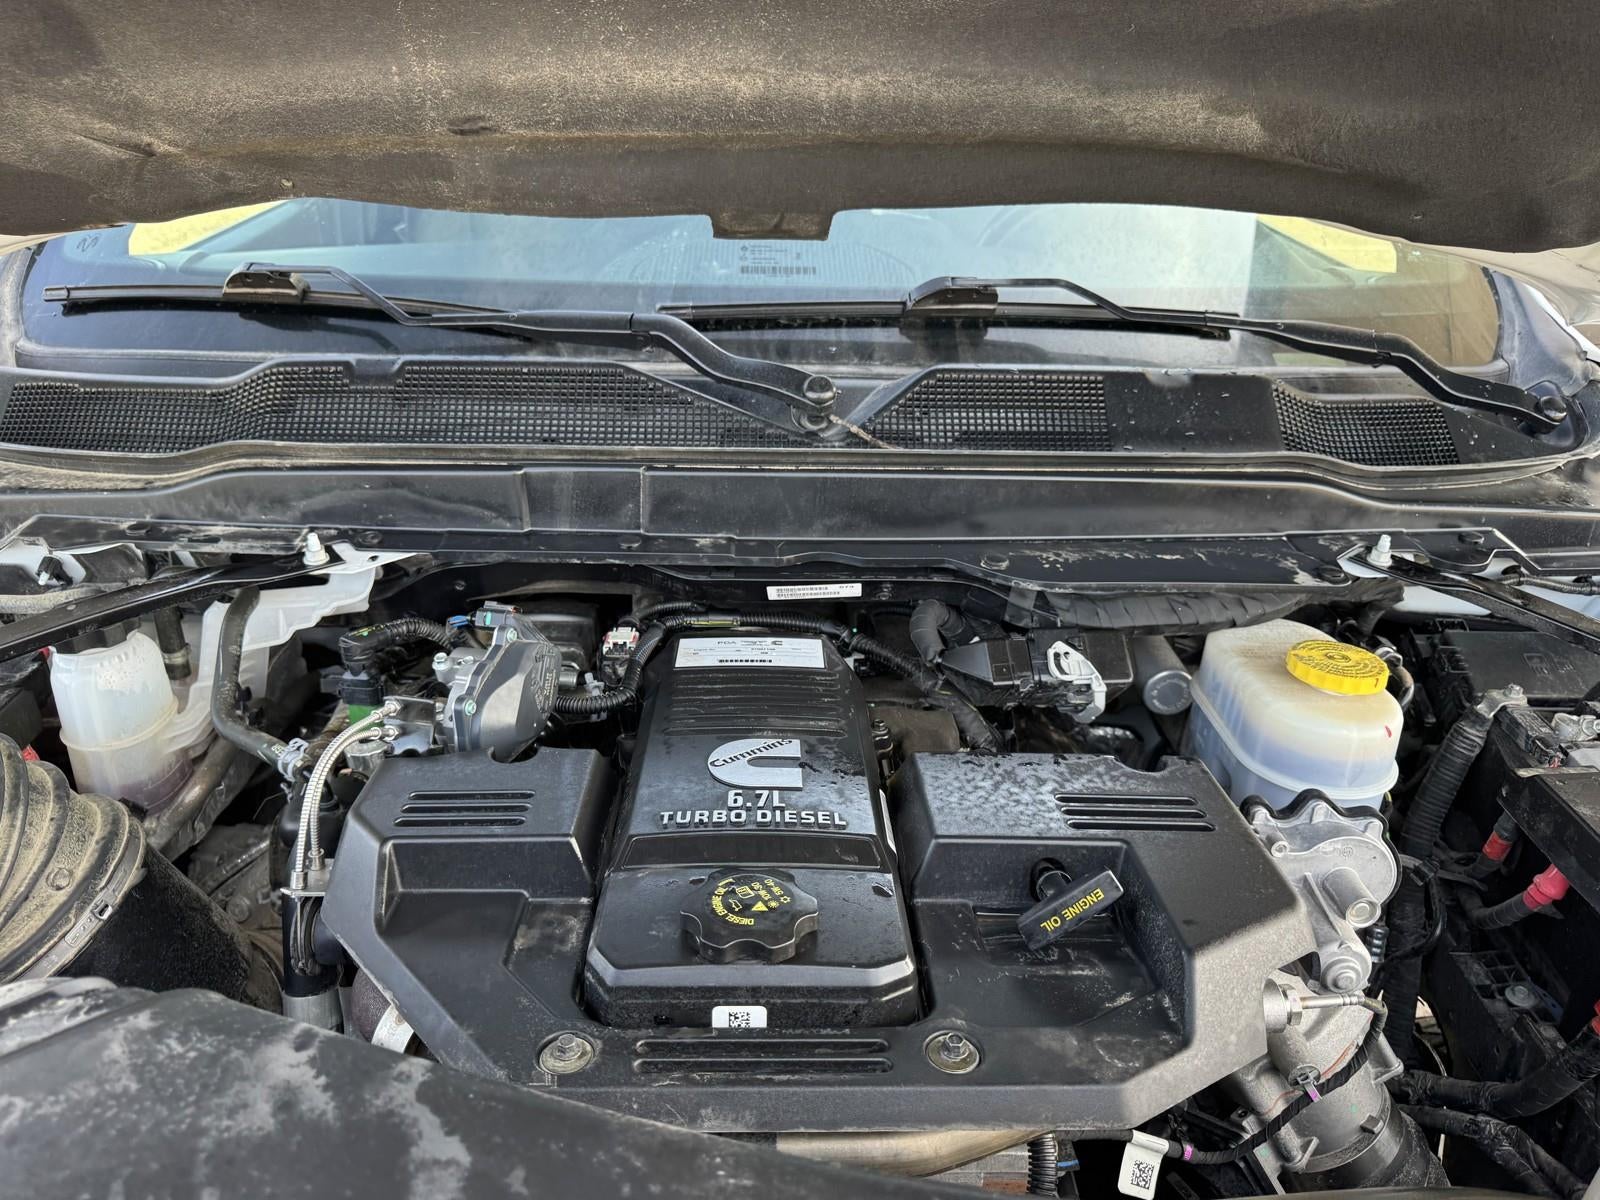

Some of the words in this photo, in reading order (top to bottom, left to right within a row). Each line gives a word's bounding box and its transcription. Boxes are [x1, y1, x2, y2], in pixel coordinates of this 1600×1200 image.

[709, 738, 793, 768] Cummins
[727, 789, 786, 810] 6.7L
[660, 810, 747, 829] TURBO
[756, 809, 847, 829] DIESEL
[1061, 888, 1104, 920] ENGINE
[725, 913, 755, 925] DIESEL
[1040, 916, 1061, 932] OIL
